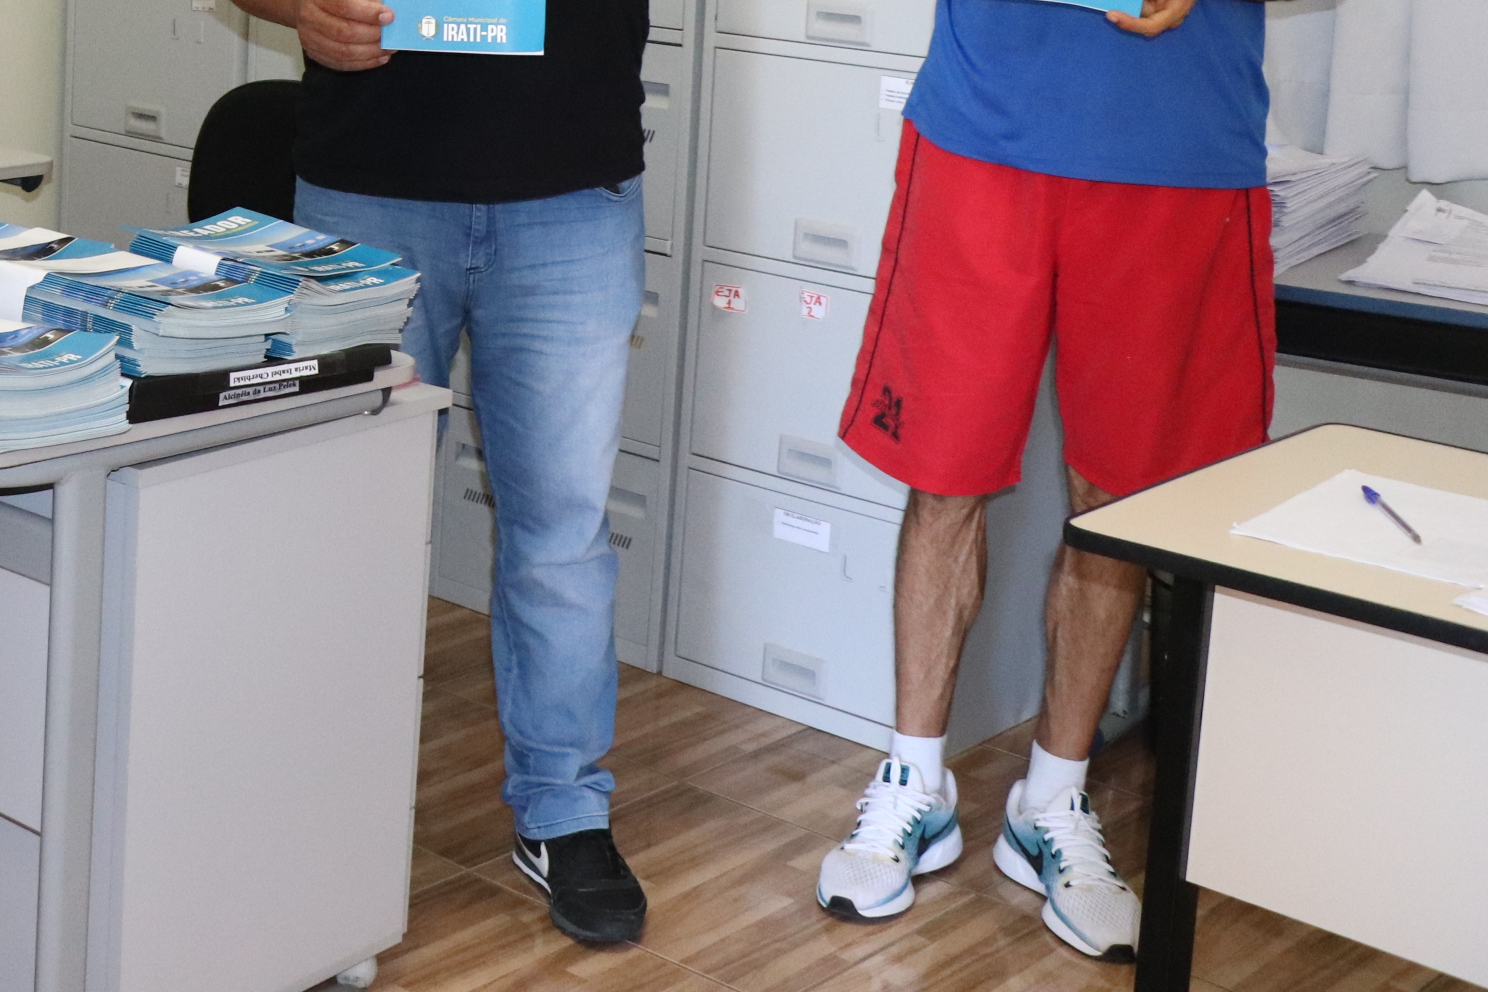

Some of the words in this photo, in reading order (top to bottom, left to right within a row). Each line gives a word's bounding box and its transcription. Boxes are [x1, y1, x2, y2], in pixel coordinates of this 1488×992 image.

[443, 23, 507, 43] IRATI-PR
[714, 287, 741, 298] EJA
[271, 368, 293, 378] Isabel
[294, 363, 317, 373] Maria
[233, 372, 269, 384] Cherbiski
[263, 384, 277, 394] Luz
[278, 380, 297, 391] Pelek
